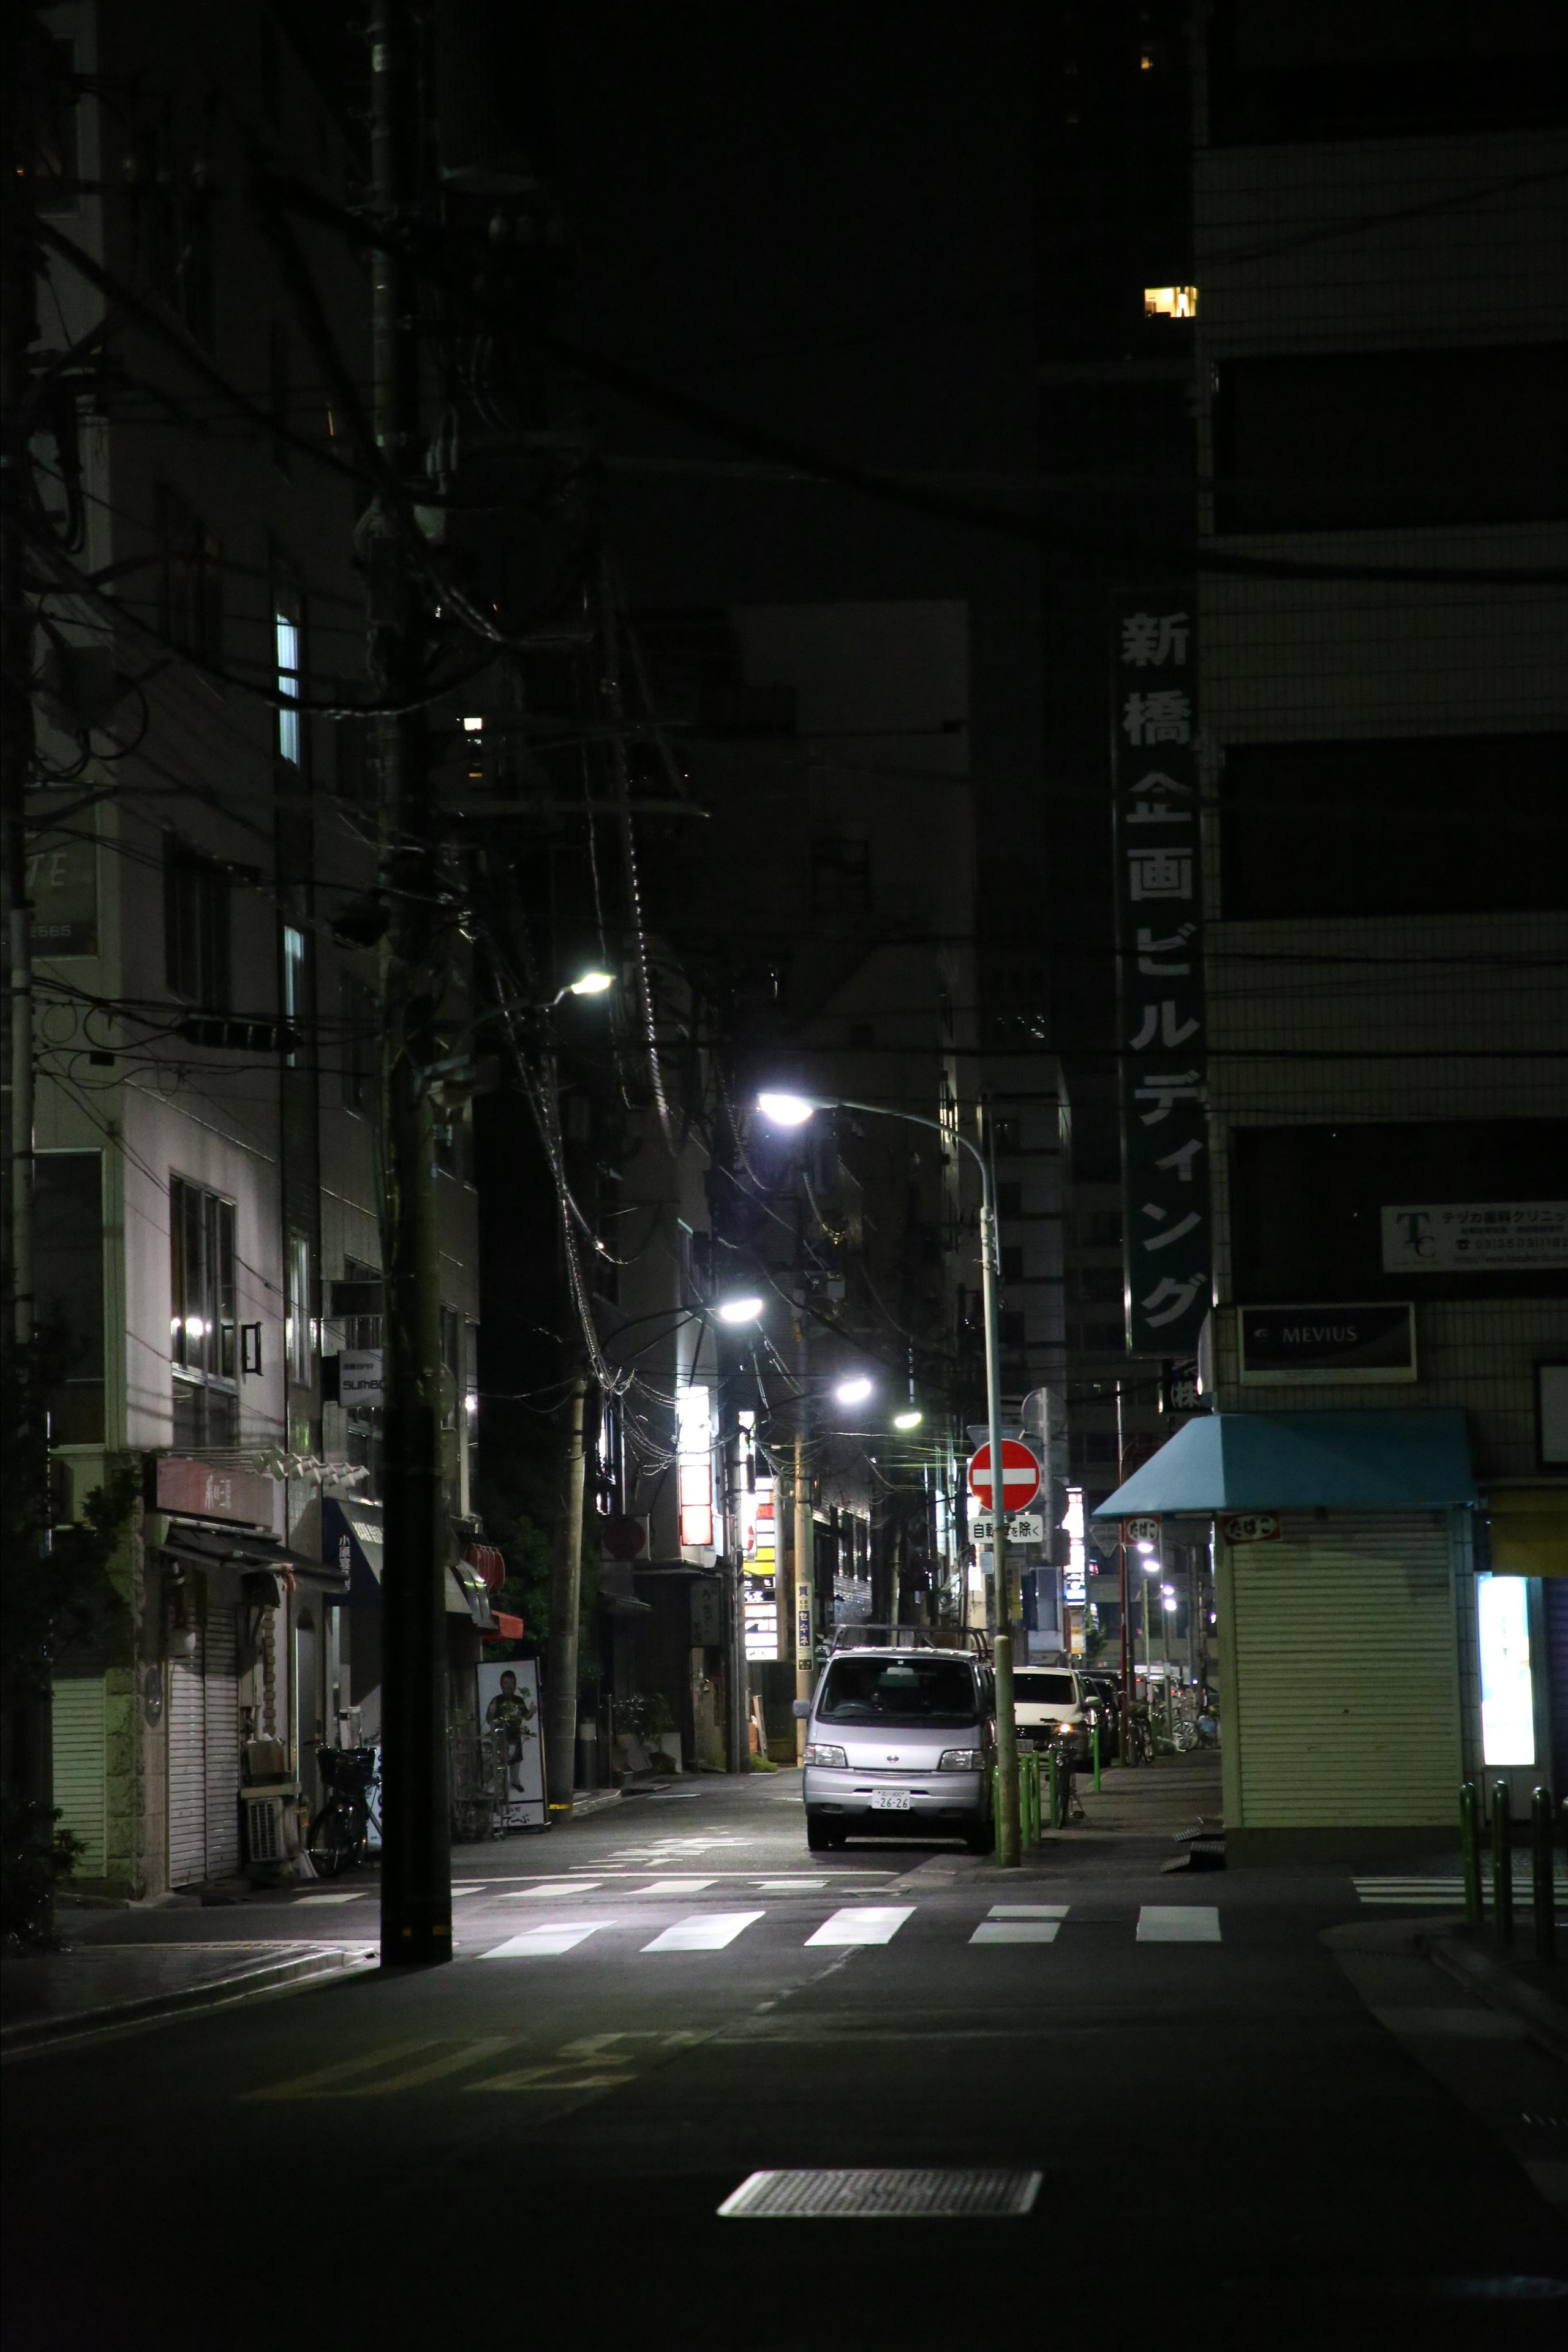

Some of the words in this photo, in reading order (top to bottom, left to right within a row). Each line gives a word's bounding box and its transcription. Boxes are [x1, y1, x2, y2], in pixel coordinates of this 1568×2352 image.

[1120, 611, 1208, 1329] 新橋企画ビルディング
[1283, 1327, 1357, 1343] MEVIUS
[1230, 1517, 1270, 1537] たばこ
[799, 1612, 809, 1645] セキネ
[880, 1798, 908, 1808] 26-26
